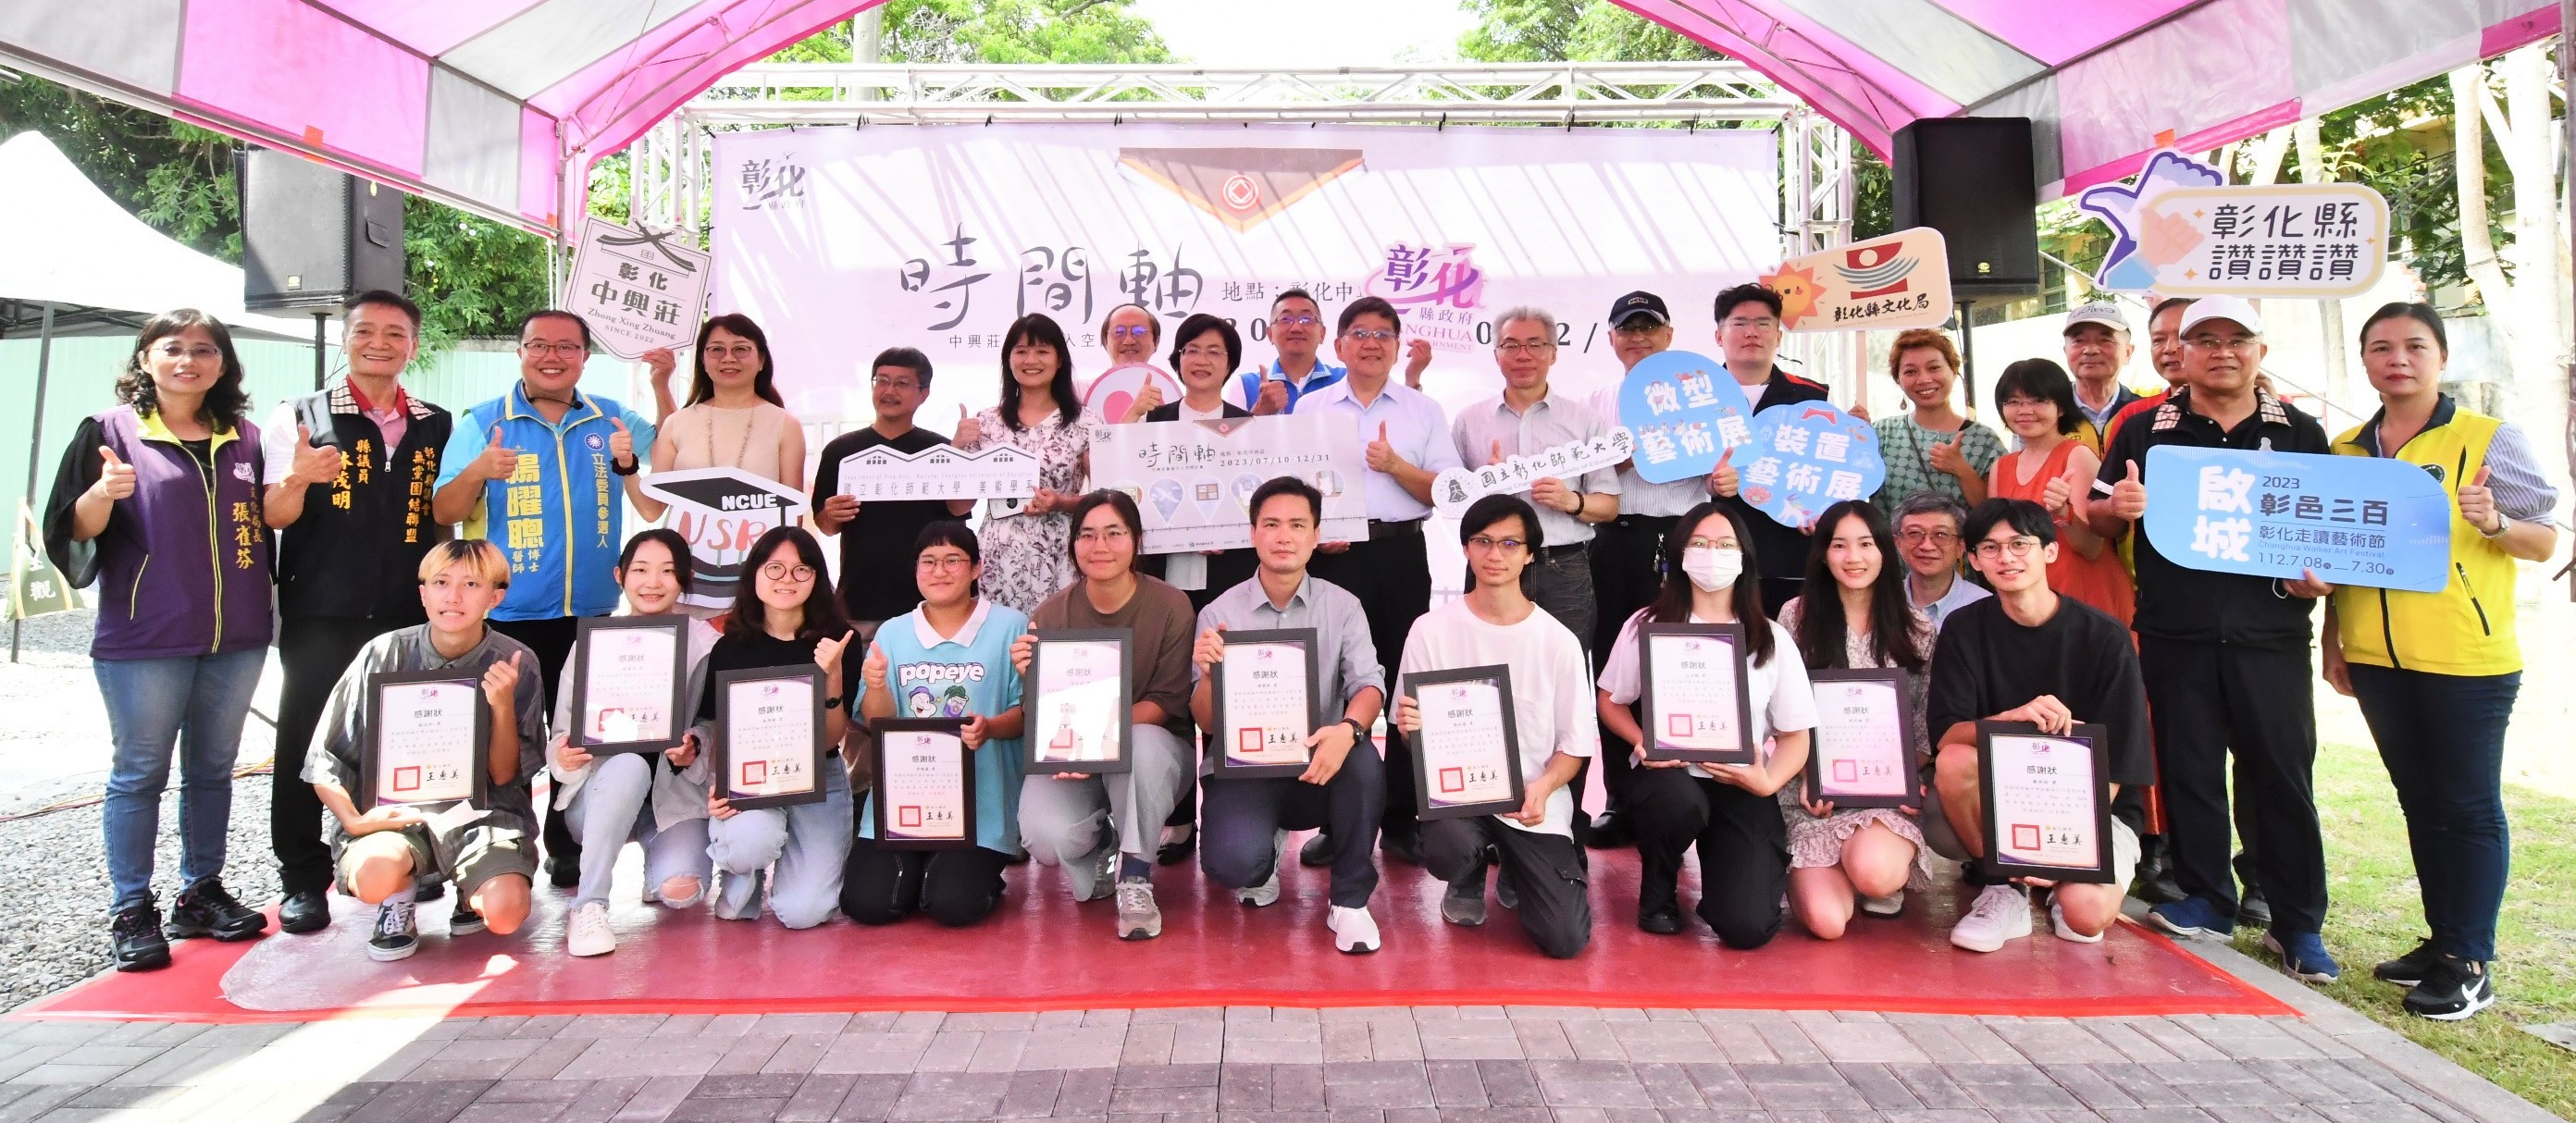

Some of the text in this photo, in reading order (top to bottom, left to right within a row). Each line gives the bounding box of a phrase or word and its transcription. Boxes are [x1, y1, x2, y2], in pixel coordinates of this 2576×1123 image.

[742, 158, 805, 202] 彰化
[2212, 203, 2359, 239] 彰化縣
[618, 262, 668, 291] 彰化
[900, 222, 1203, 331] 時間軸
[1384, 244, 1479, 308] 彰化
[2209, 243, 2359, 281] 讚讚讚
[590, 279, 682, 326] 中興莊
[1419, 307, 1474, 326] 縣政府
[1833, 292, 1929, 322] 彰化縣文化局
[588, 307, 676, 340] Zhong Xing Zhuang
[604, 325, 655, 343] SINCE 2022
[1643, 374, 1719, 415] 微型
[1138, 441, 1216, 468] 時間軸
[1639, 415, 1752, 464] 藝術展
[1774, 424, 1850, 463] 裝置
[355, 438, 372, 484] 縣議員
[1480, 431, 1629, 488] 國立彰化師範大學
[843, 479, 1033, 496] 國立彰化師範大學 美術學系
[1744, 456, 1864, 500] 藝術展
[2262, 475, 2301, 489] 2023
[591, 452, 609, 549] 立法委員參選人
[721, 493, 779, 511] NCUE
[2190, 465, 2256, 562] 啟城
[2260, 492, 2388, 526] 彰邑三百
[232, 501, 254, 569] 張雀芬
[2259, 524, 2386, 549] 彰化走讀藝術節
[527, 549, 541, 573] 博士
[898, 660, 985, 687] popeye
[1253, 671, 1279, 679] 感謝狀
[1681, 661, 1706, 670] 感謝狀
[414, 709, 443, 718] 感謝狀
[759, 705, 784, 714] 感謝狀
[1447, 708, 1473, 718] 感謝狀
[911, 755, 936, 763] 感謝狀
[2026, 765, 2058, 775] 感謝狀
